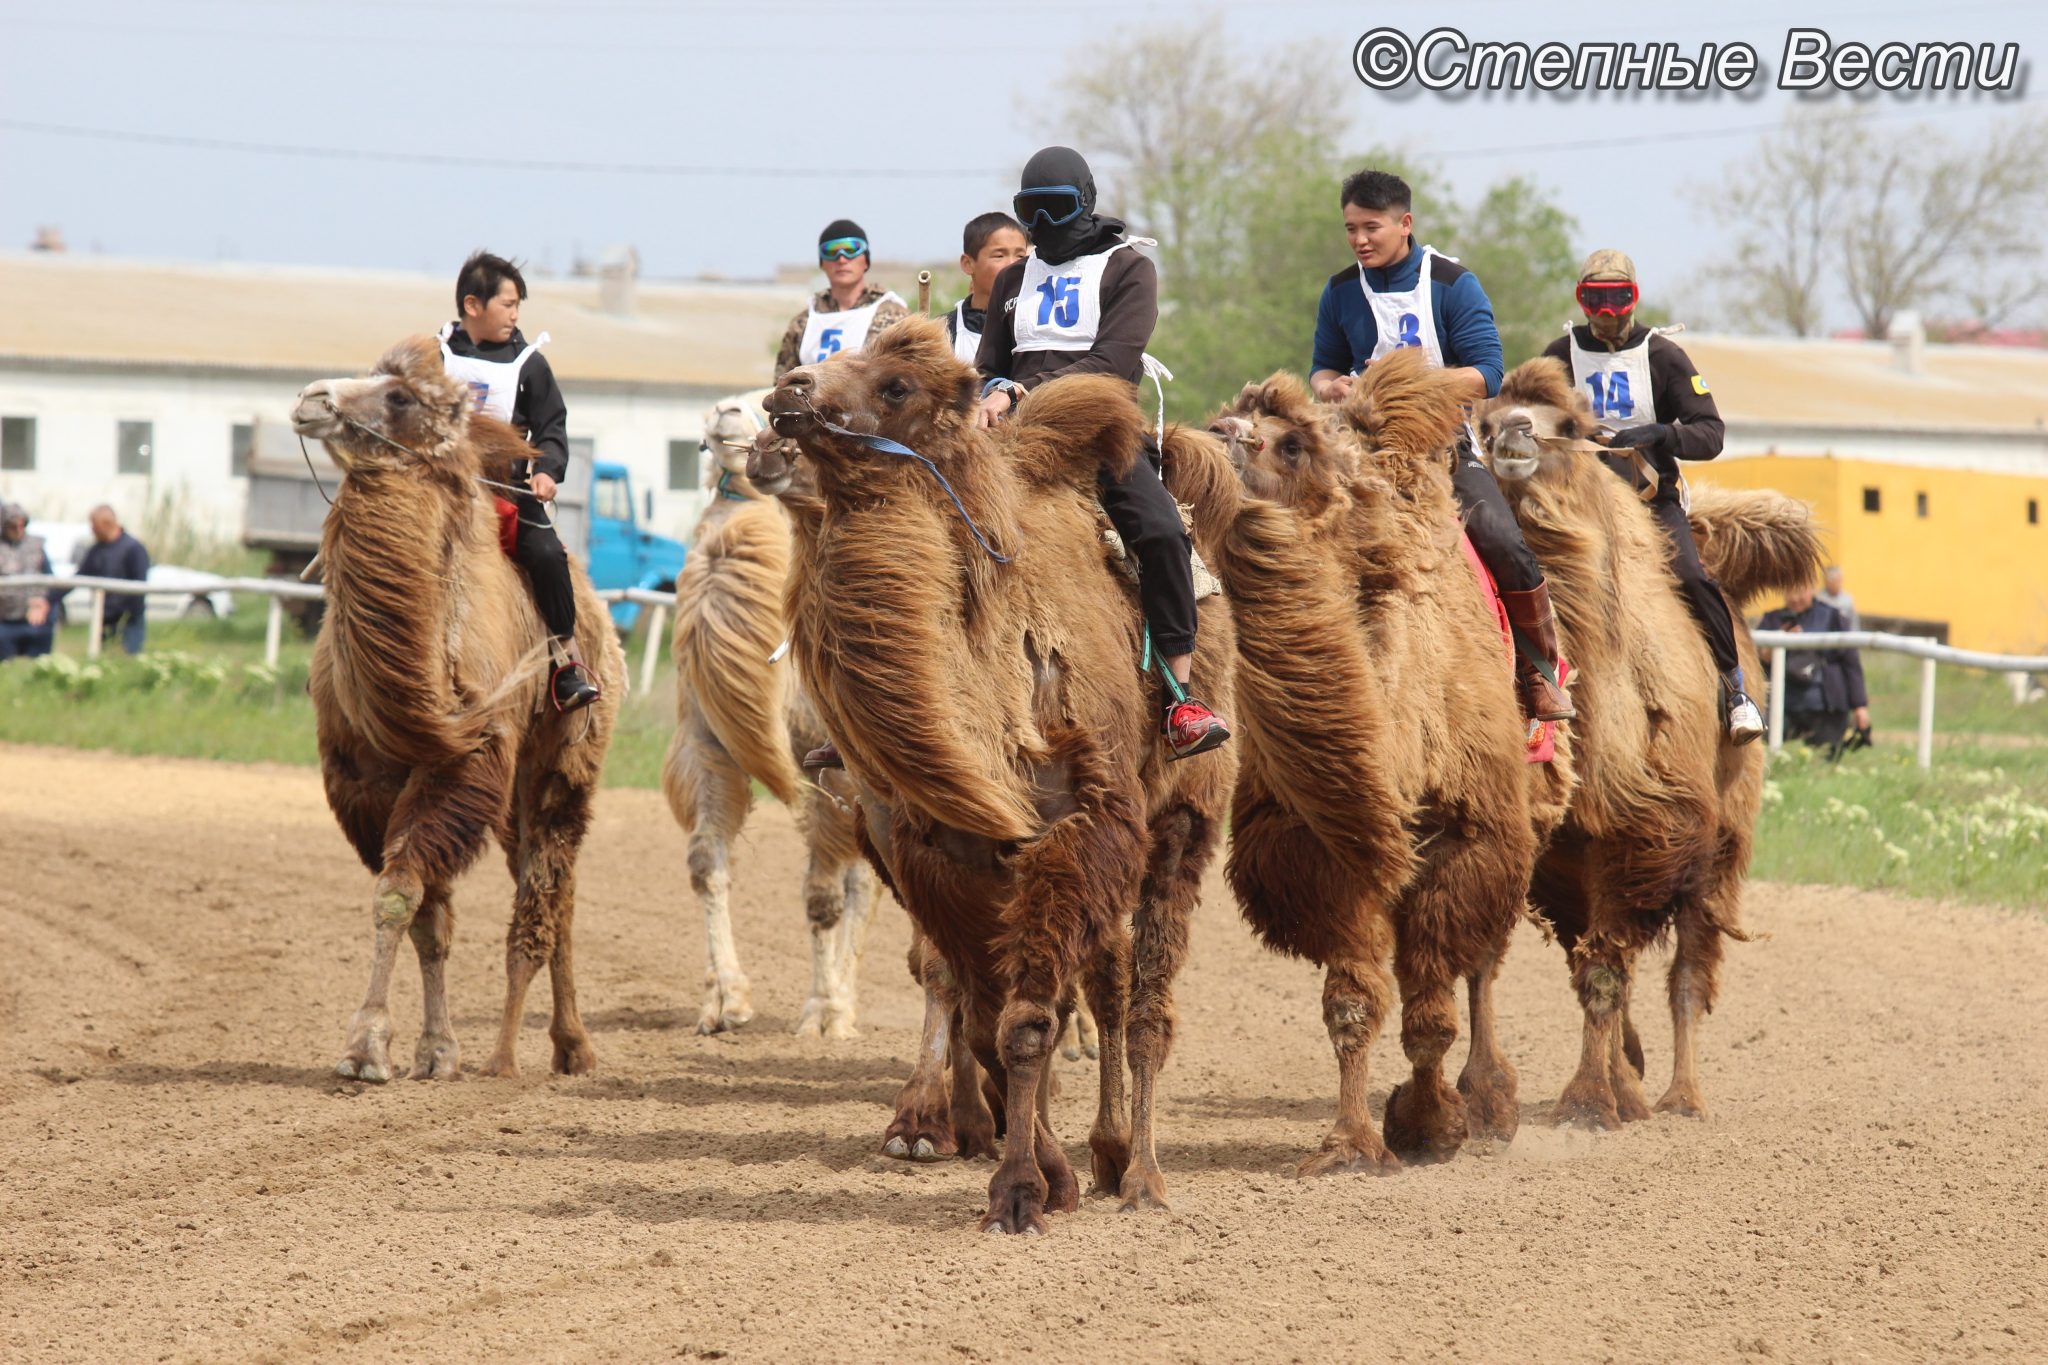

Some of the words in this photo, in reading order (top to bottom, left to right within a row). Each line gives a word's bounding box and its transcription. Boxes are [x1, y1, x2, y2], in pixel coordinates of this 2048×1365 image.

[1036, 275, 1082, 328] 15
[816, 328, 843, 363] 5
[1396, 312, 1422, 349] 3
[1585, 371, 1634, 418] 14
